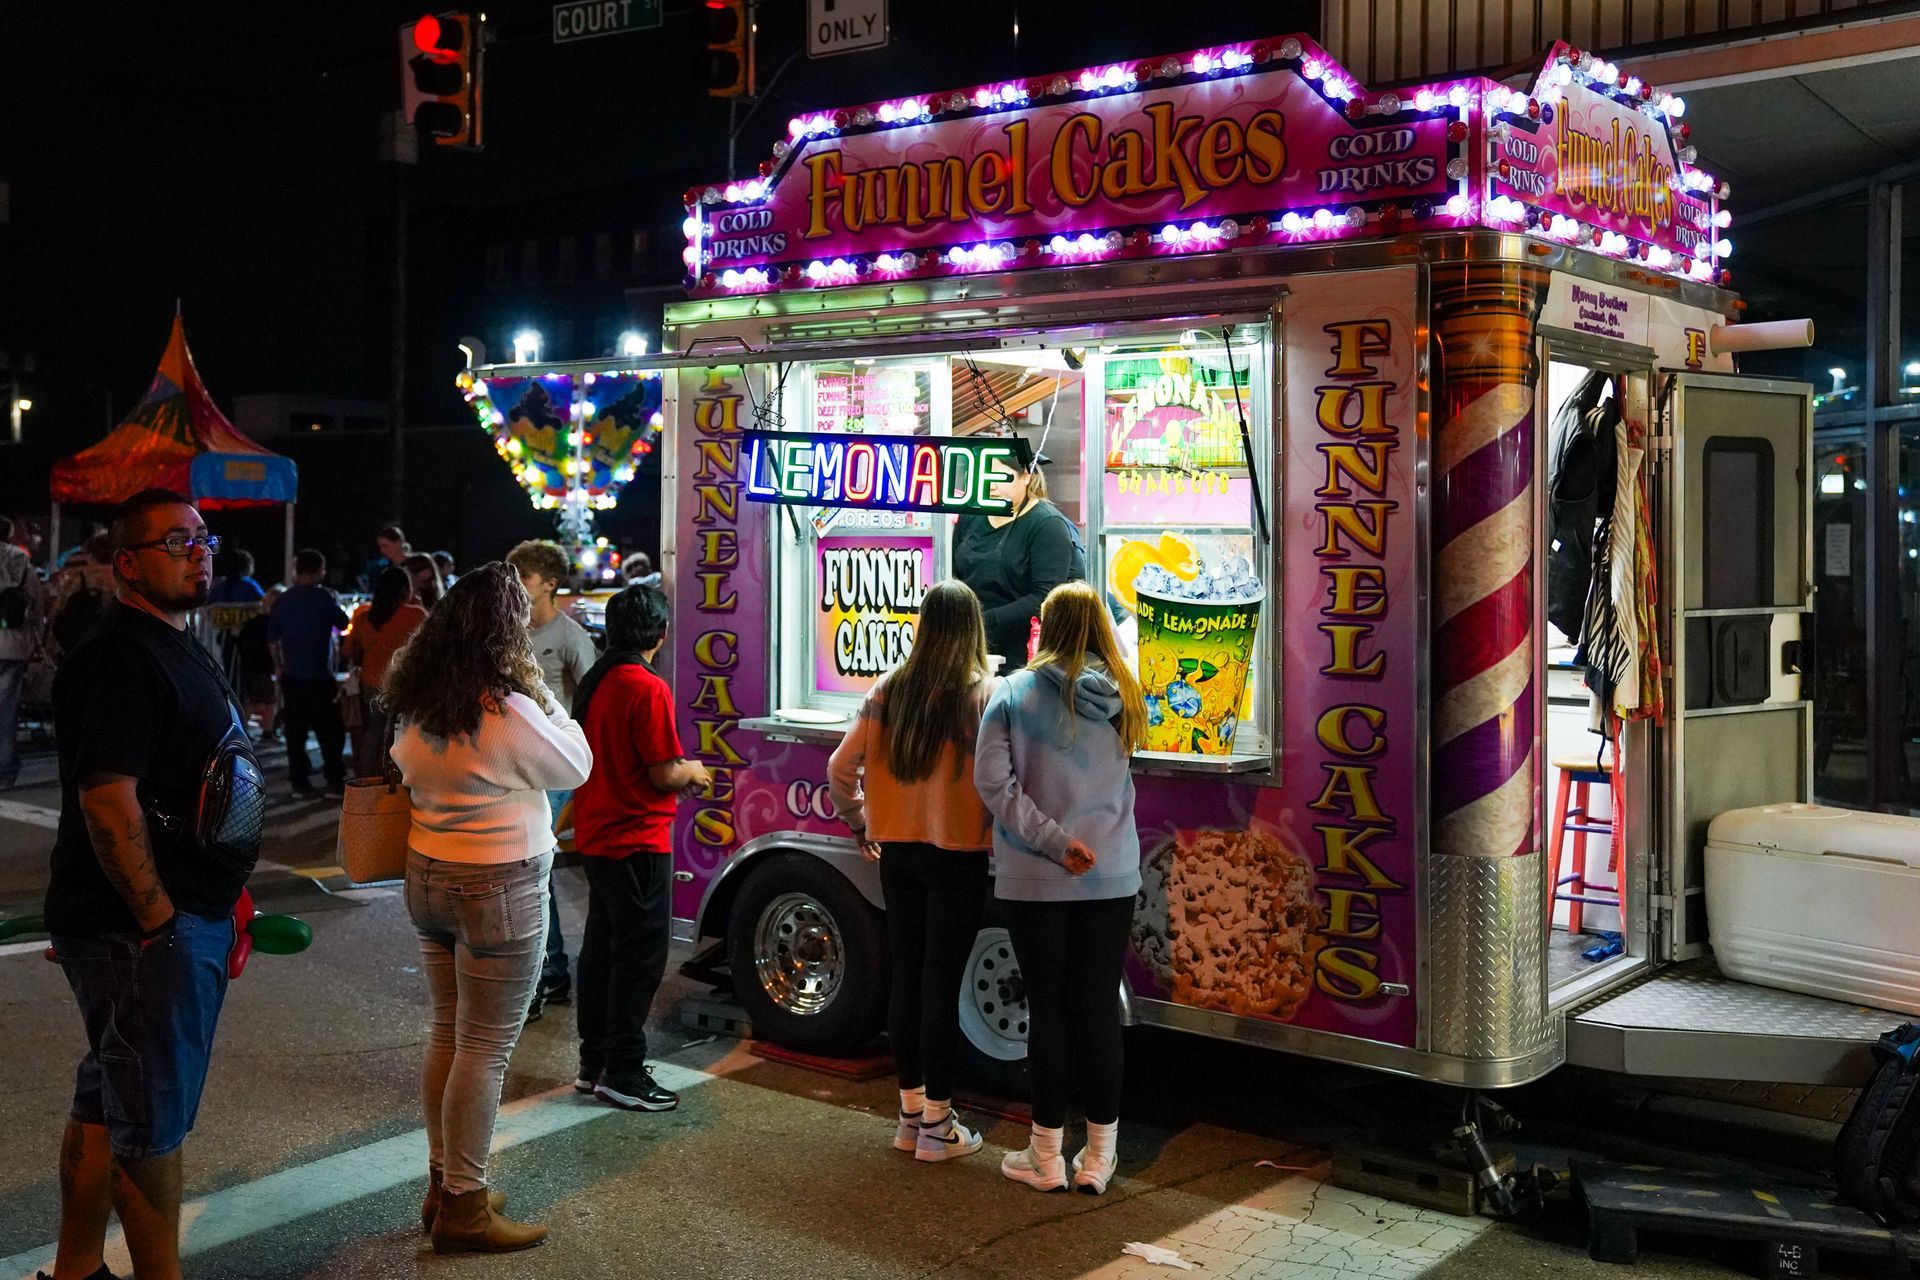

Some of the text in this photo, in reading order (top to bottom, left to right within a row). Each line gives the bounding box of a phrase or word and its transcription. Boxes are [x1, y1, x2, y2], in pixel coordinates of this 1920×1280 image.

[557, 0, 632, 36] COURT
[819, 14, 876, 44] ONLY
[1328, 128, 1414, 161] COLD
[1505, 136, 1538, 164] COLD
[1556, 97, 1620, 214] Funnel
[803, 102, 1287, 239] Funnel Cakes
[1318, 156, 1435, 194] DRINKS
[1502, 164, 1545, 197] RINKS
[1623, 127, 1672, 240] Cakes
[719, 210, 773, 233] COLD
[711, 232, 787, 259] DRINKS
[817, 420, 834, 432] POP
[748, 438, 1014, 508] LEMONADE
[1314, 319, 1401, 680] FUNNEL
[822, 548, 928, 613] FUNNEL
[1163, 612, 1247, 634] LEMONADE
[834, 618, 914, 676] CAKES
[690, 628, 750, 848] CAKES
[1308, 703, 1406, 1002] CAKES
[1779, 1260, 1798, 1270] INC
